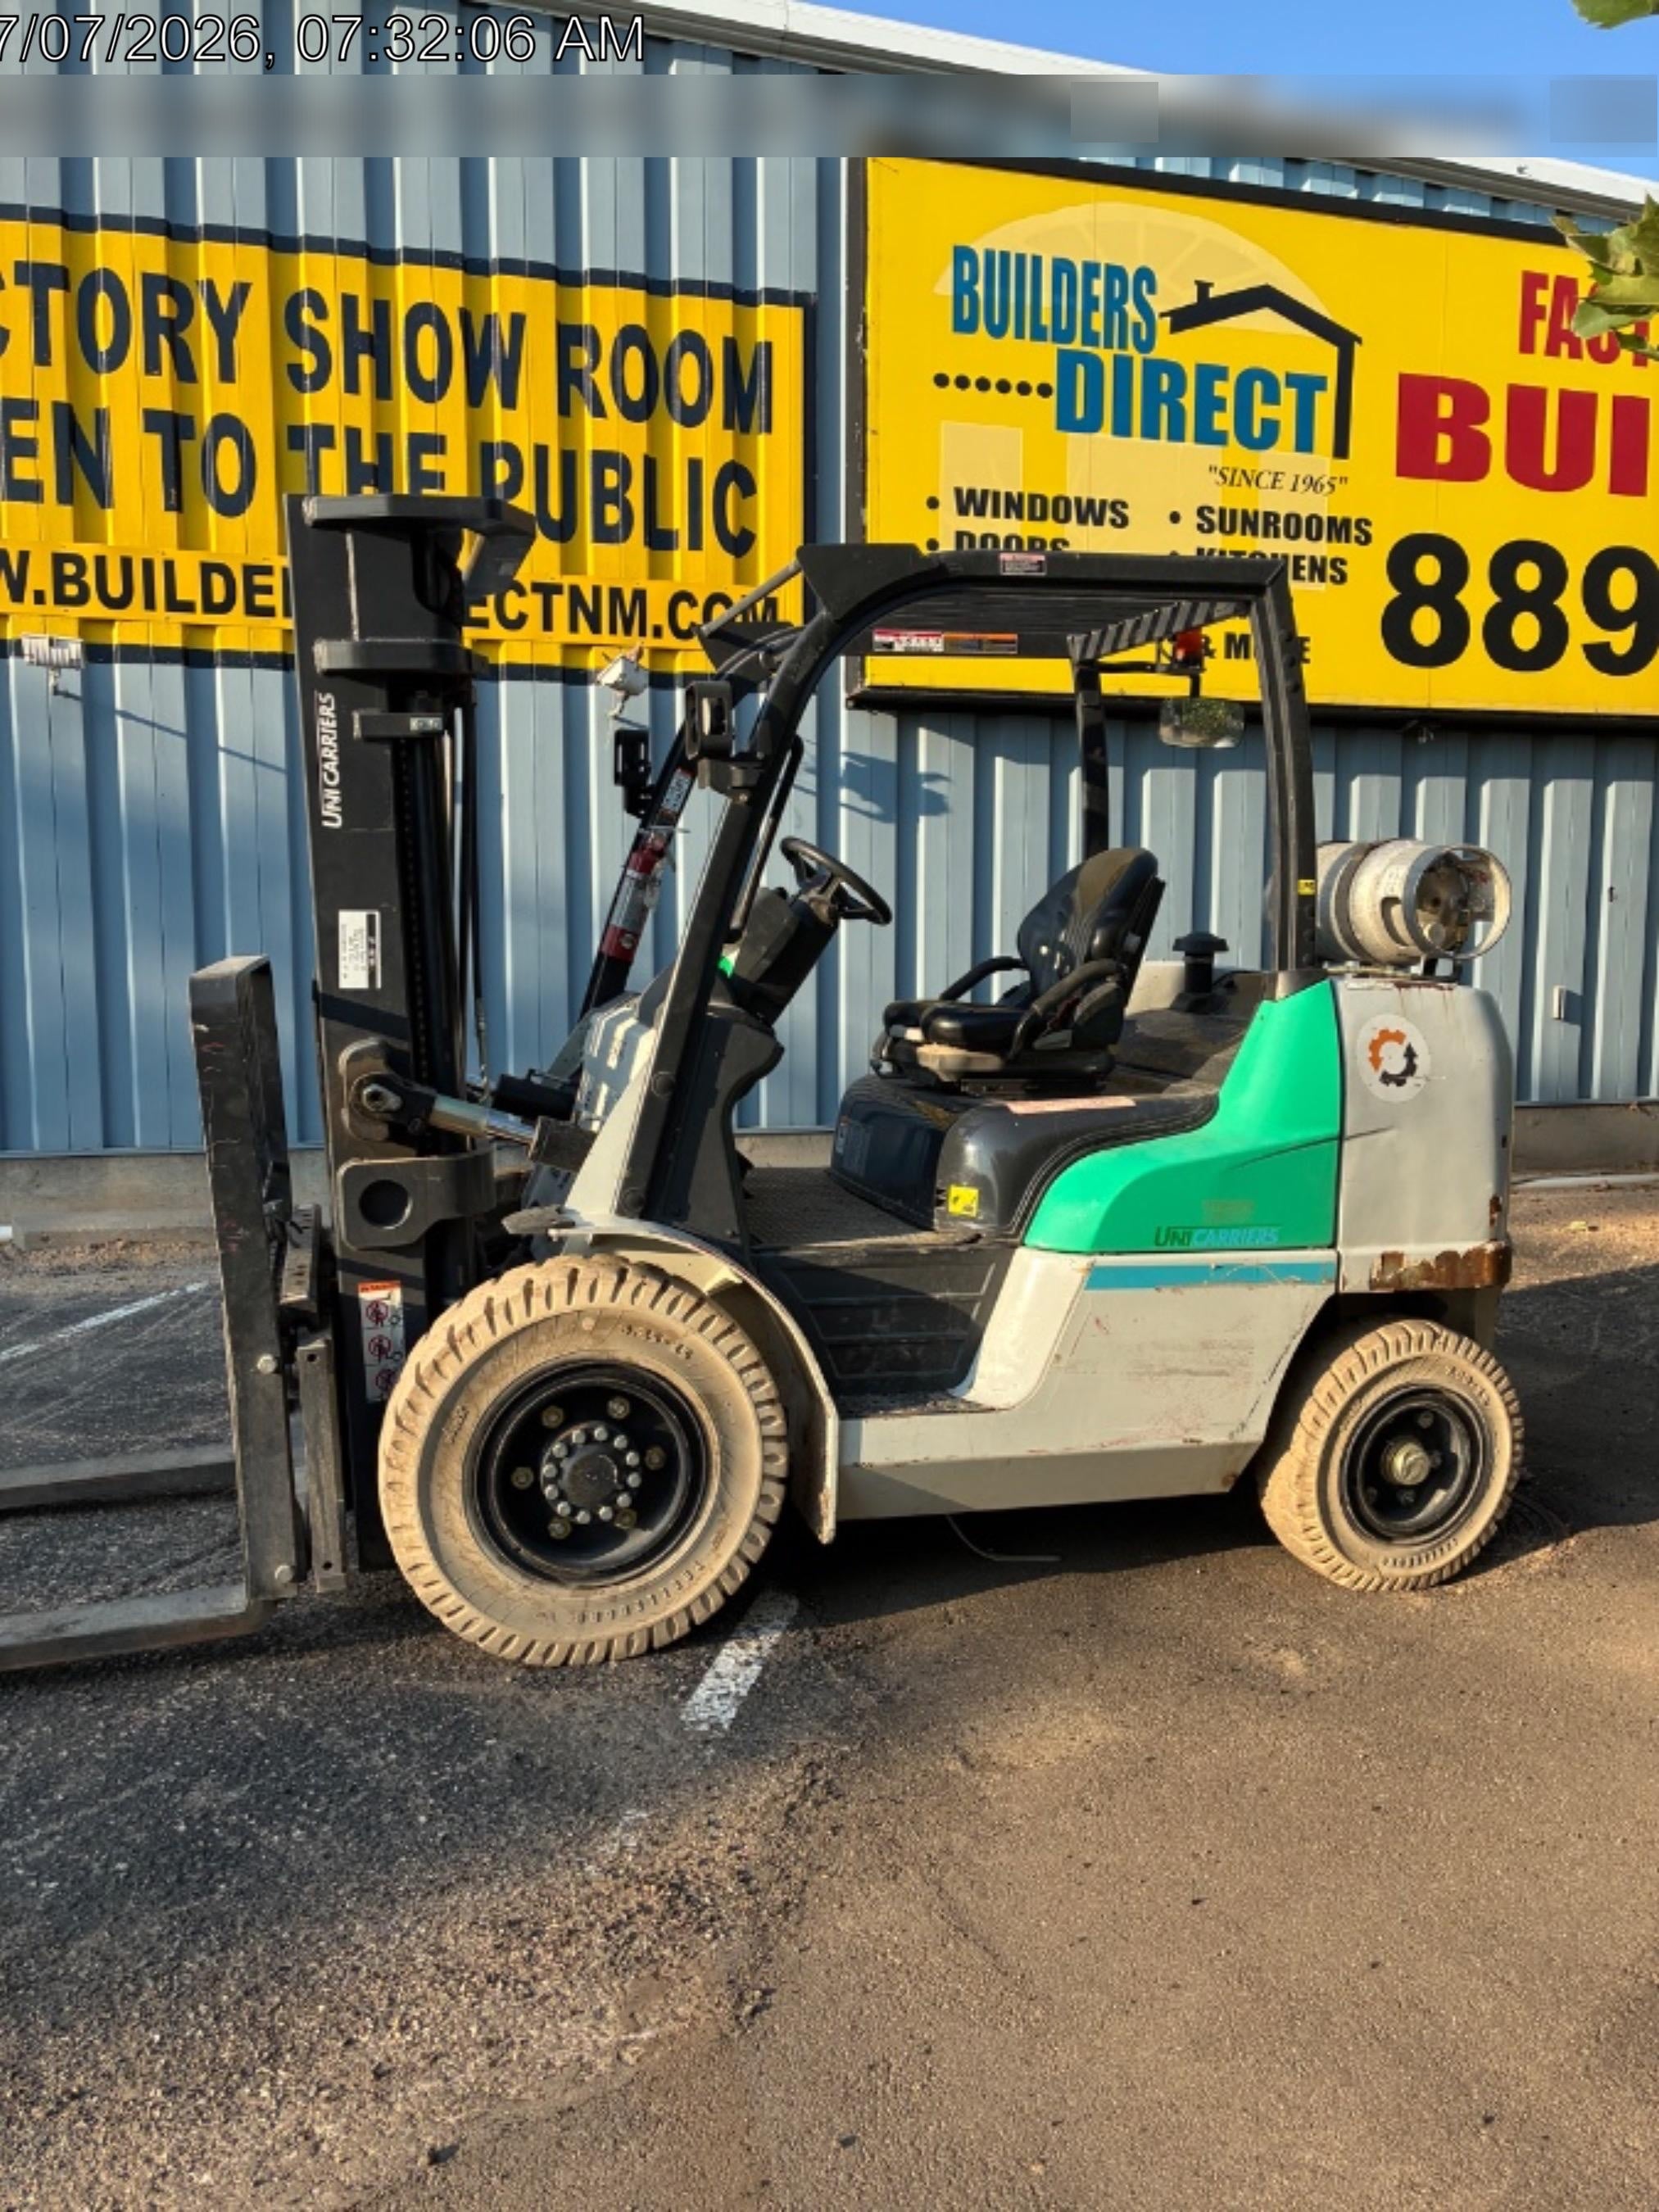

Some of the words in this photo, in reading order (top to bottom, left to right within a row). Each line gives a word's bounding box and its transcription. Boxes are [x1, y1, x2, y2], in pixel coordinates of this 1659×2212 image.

[0, 261, 252, 384] TORY
[283, 287, 527, 410] SHOW
[556, 322, 773, 434] ROOM
[953, 244, 1157, 354] BUILDERS
[1055, 347, 1328, 456] DIRECT
[1395, 371, 1650, 497] BUI
[0, 397, 114, 510] EN
[142, 408, 257, 519] TO
[287, 424, 448, 495] THE
[479, 441, 758, 559] PUBLIC
[954, 487, 1130, 528] WINDOWS
[1196, 505, 1373, 546] SUNROOMS
[1208, 465, 1285, 490] "SINCE
[1290, 474, 1349, 496] 1965"
[1380, 532, 1659, 677] 889
[316, 692, 342, 829] UNICARRIERS
